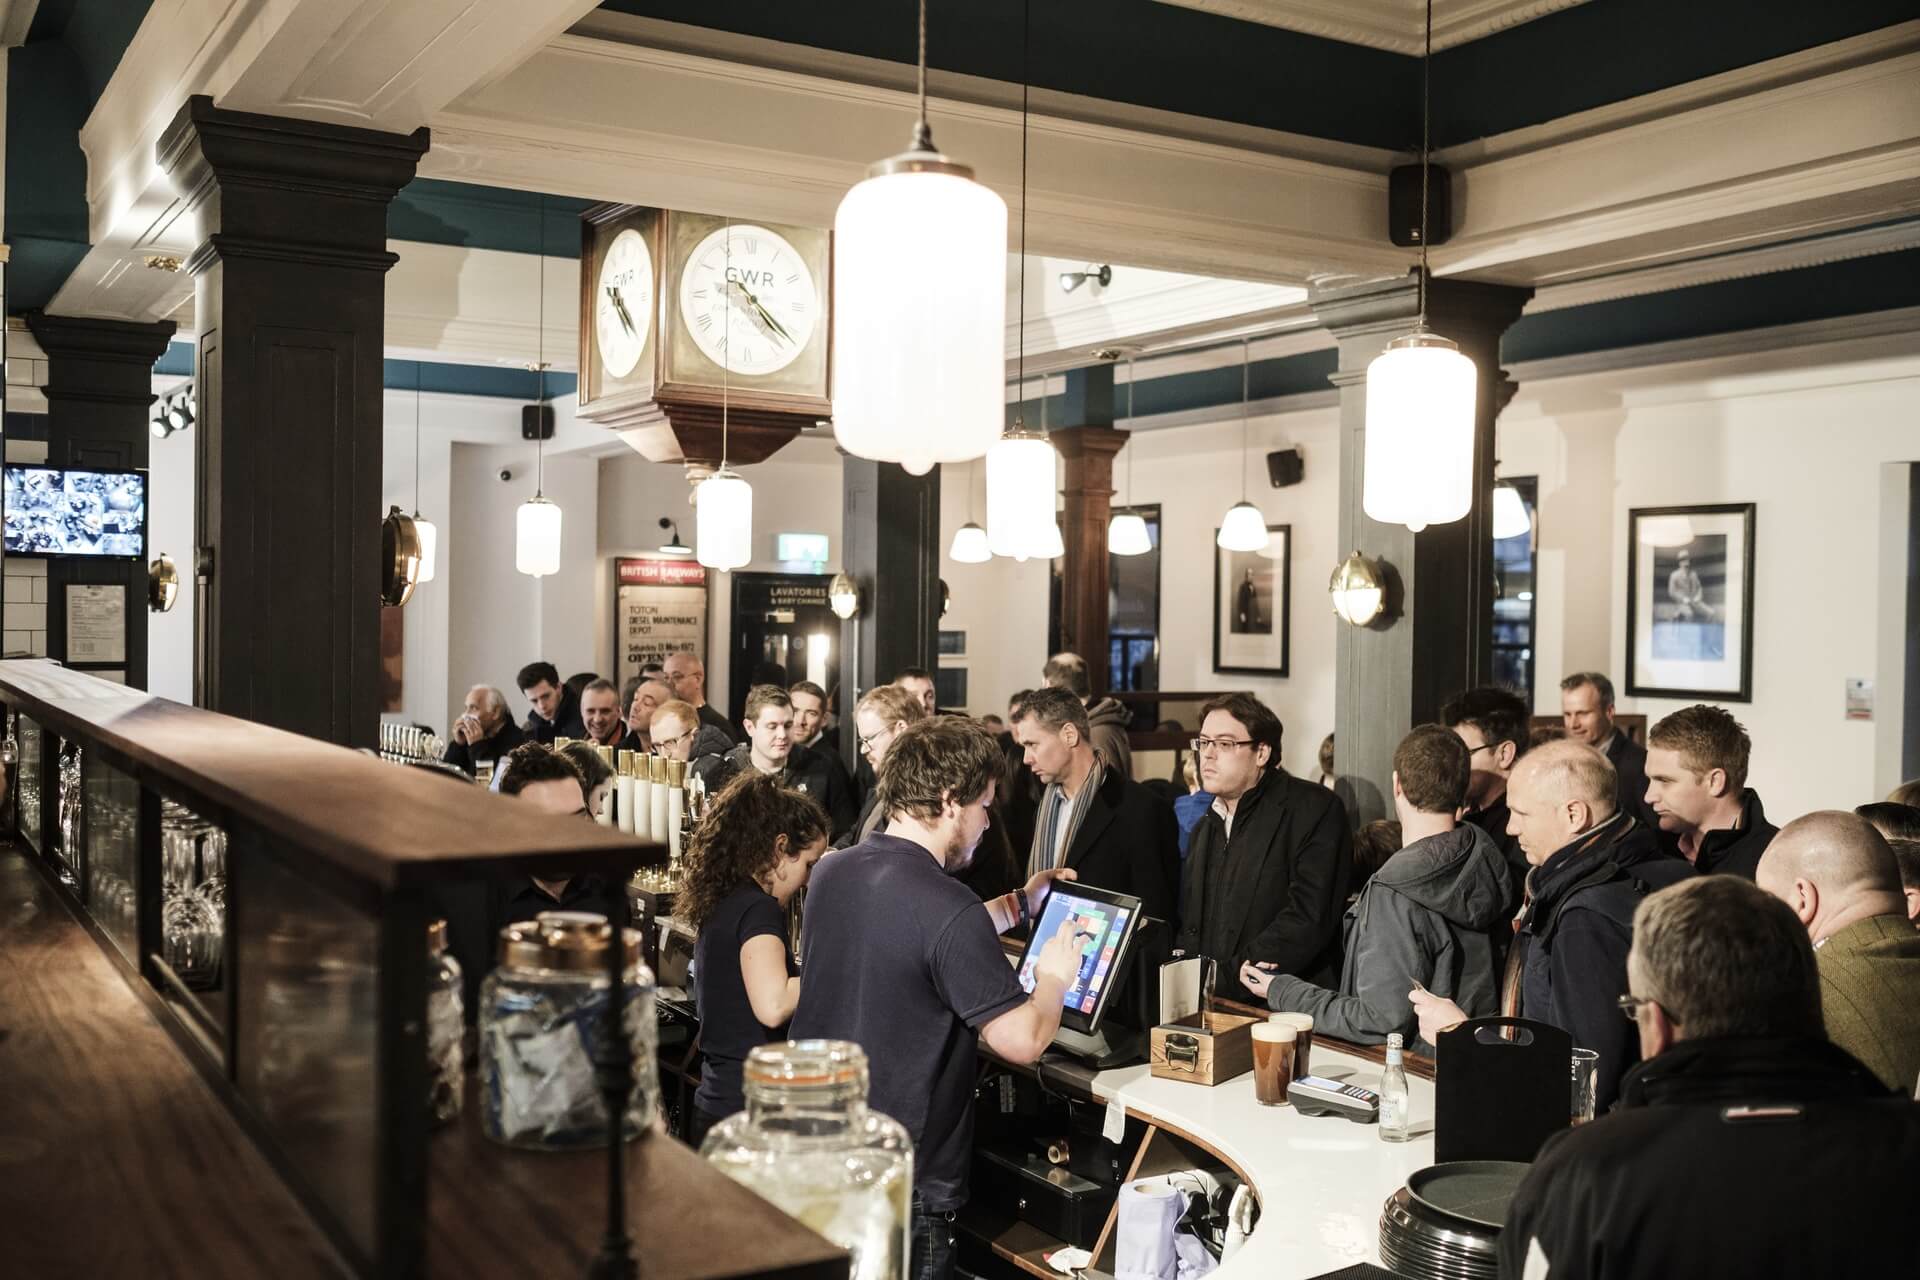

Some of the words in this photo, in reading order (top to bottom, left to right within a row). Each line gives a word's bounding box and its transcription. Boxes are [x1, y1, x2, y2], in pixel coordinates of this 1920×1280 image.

[613, 268, 634, 287] GWR
[725, 267, 774, 288] GWR
[621, 566, 658, 577] BRITISH
[771, 587, 826, 596] LAVATORIES
[629, 606, 658, 615] TOTON
[628, 616, 650, 625] DIESEL
[652, 616, 697, 625] MAINTENANCE
[629, 626, 652, 634] DEPOT
[628, 653, 664, 663] OPEN
